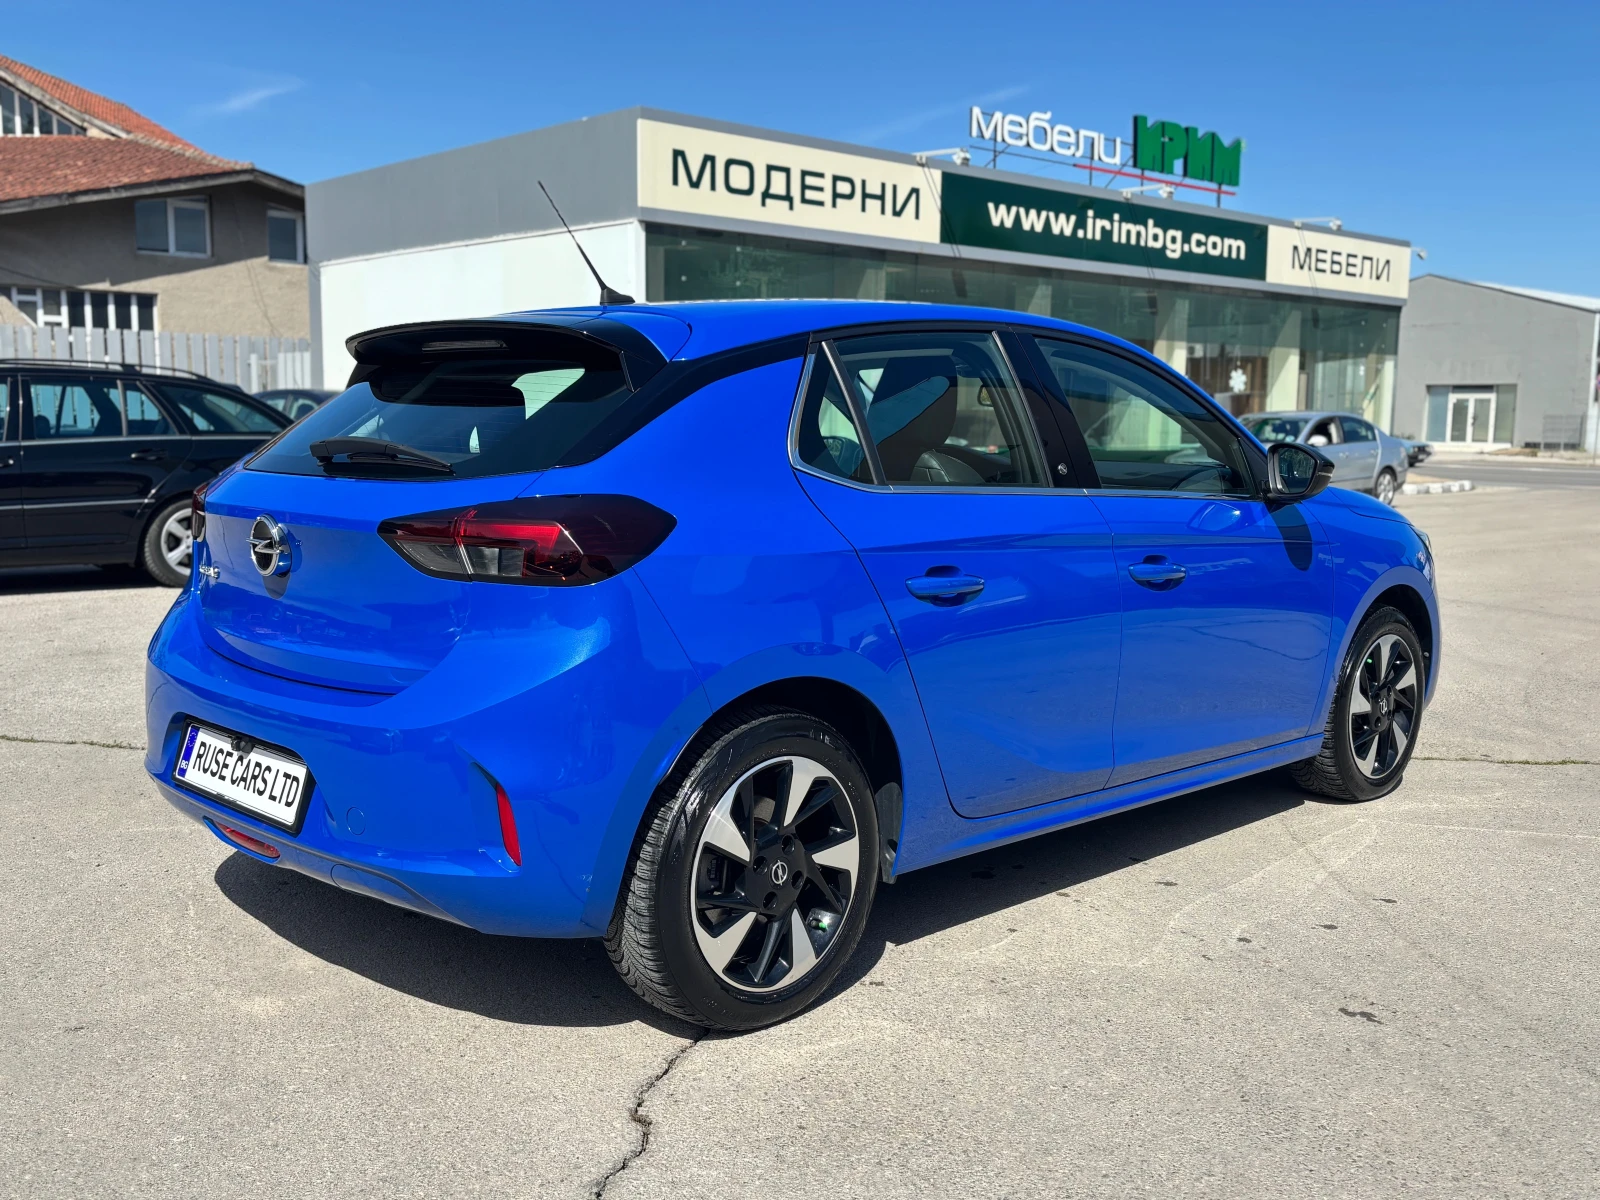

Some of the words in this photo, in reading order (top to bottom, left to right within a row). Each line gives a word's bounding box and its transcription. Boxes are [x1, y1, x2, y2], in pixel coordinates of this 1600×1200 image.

[971, 106, 1122, 165] Мебели
[1133, 114, 1242, 187] ИРИМ
[671, 148, 920, 220] МОДЕРНИ
[987, 202, 1246, 260] www.irimbg.com
[1291, 244, 1391, 282] МЕБЕЛИ
[181, 760, 188, 769] BG
[193, 741, 233, 781] RUSE
[230, 755, 272, 796] CARS
[268, 768, 300, 808] LTD
